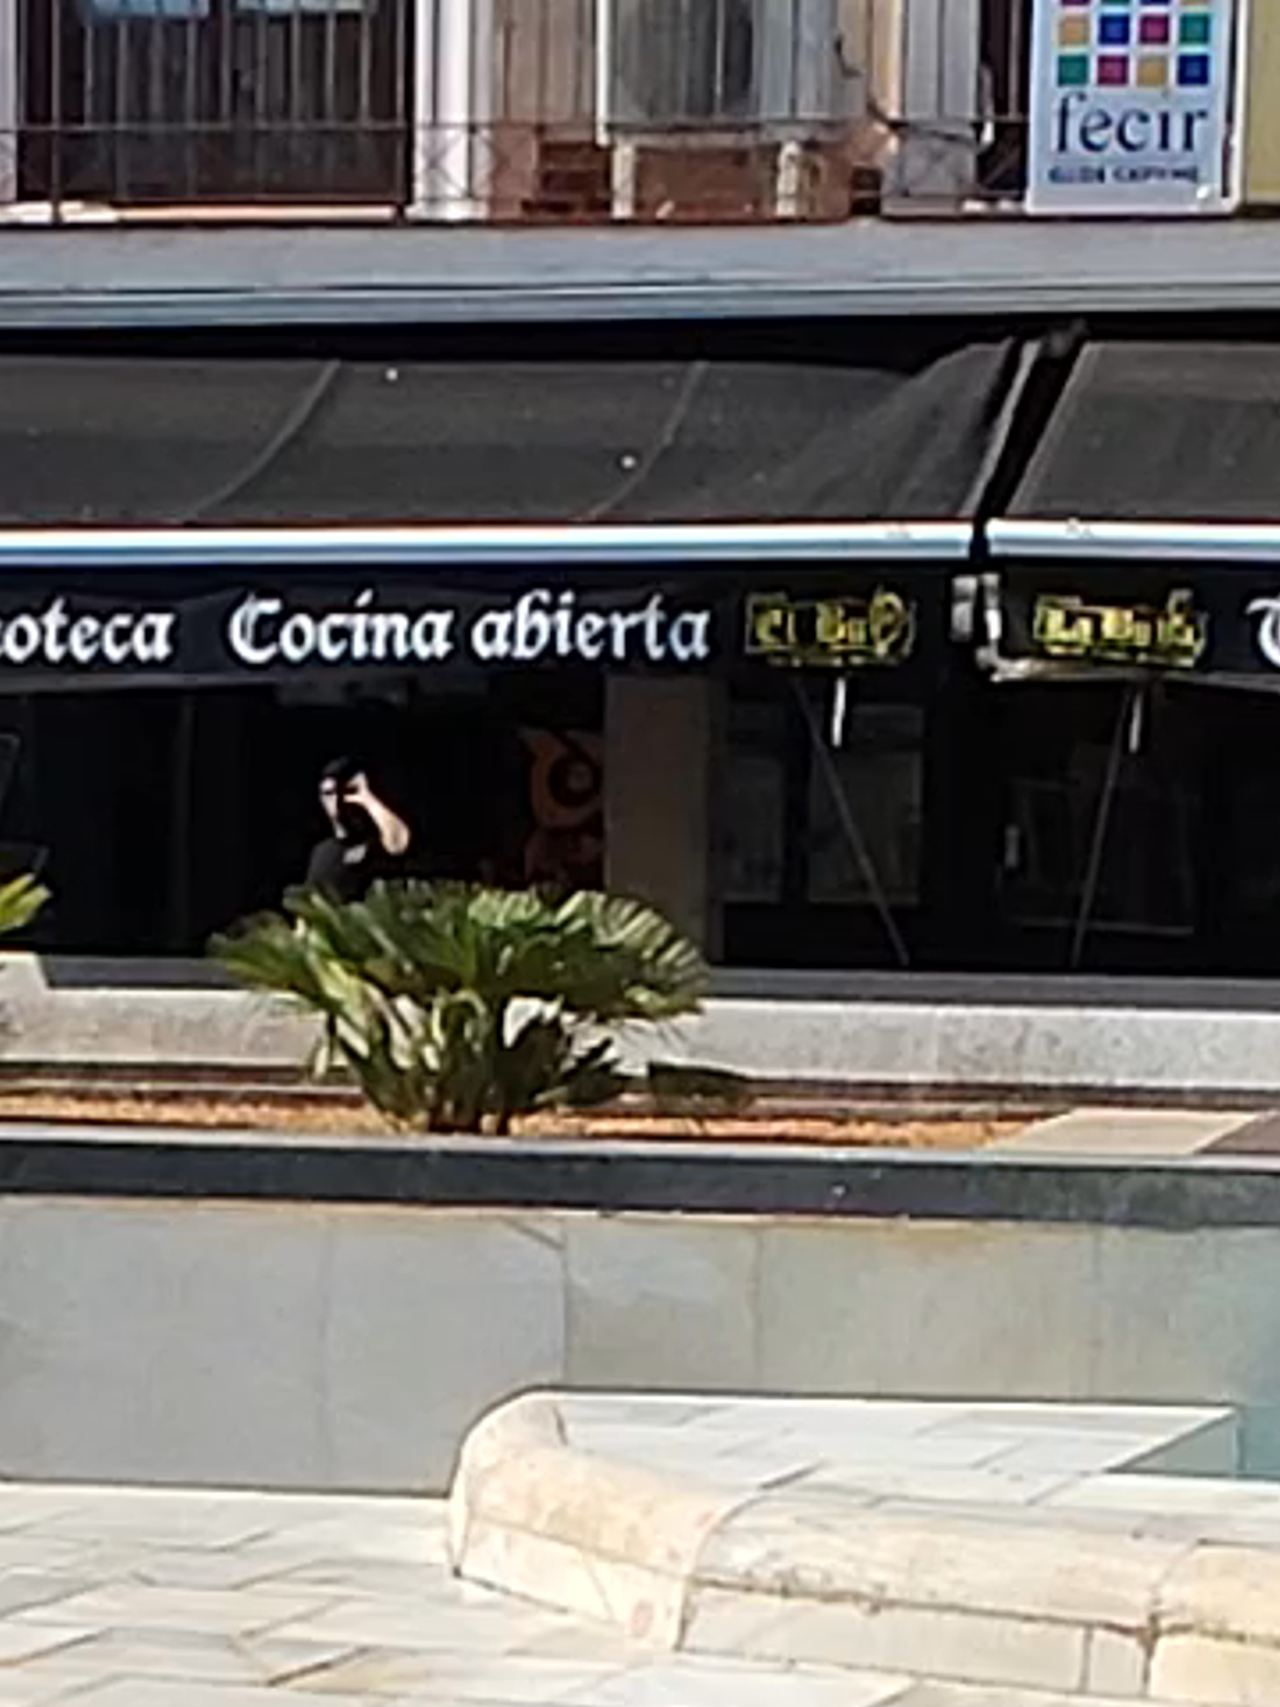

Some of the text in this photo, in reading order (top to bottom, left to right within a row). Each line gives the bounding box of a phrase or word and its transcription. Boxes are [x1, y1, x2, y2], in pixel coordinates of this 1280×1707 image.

[1057, 91, 1208, 153] fecir
[228, 591, 454, 663] Cocina
[470, 591, 712, 661] abierta
